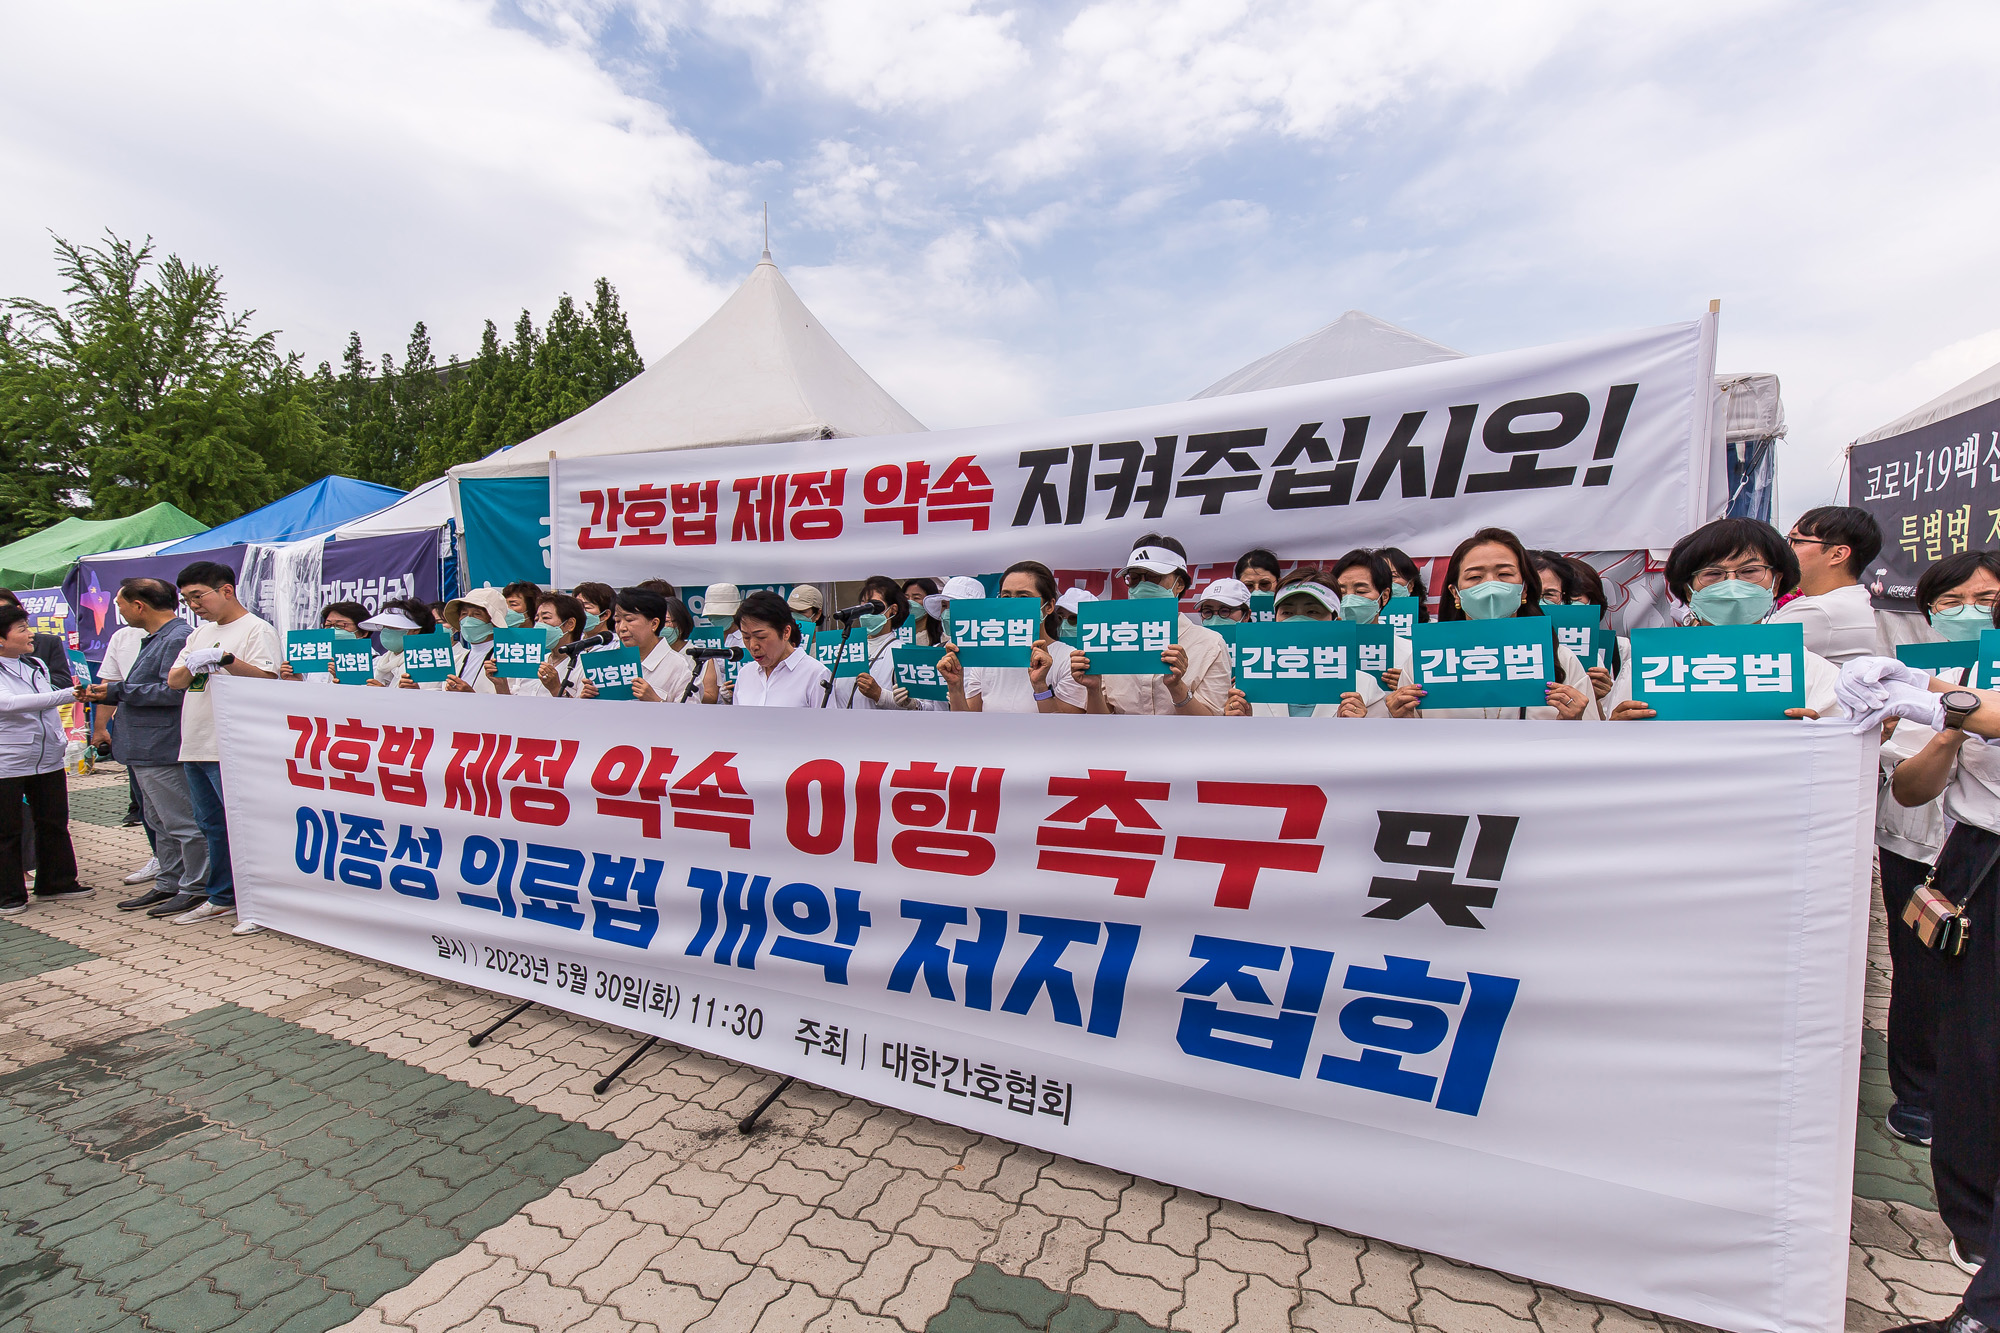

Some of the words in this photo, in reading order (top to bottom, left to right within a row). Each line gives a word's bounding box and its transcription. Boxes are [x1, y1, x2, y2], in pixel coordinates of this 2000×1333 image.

[577, 479, 721, 550] 간호법
[731, 468, 848, 543] 제정
[863, 455, 995, 536] 약속
[1011, 383, 1640, 527] 지켜주십시오!
[1899, 504, 1971, 563] 특별법
[955, 618, 1034, 647] 간호법
[1082, 621, 1171, 653] 간호법
[288, 642, 332, 661] 간호법
[335, 653, 370, 672] 간호법
[405, 647, 452, 669] 간호법
[495, 643, 542, 664] 간호법
[818, 642, 865, 665] 간호법
[1242, 645, 1347, 680] 간호법
[1420, 643, 1544, 684] 간호법
[586, 662, 639, 689] 간호법
[1641, 653, 1793, 693] 간호법
[285, 715, 435, 809] 간호법
[443, 731, 580, 828] 제정
[590, 744, 756, 851] 약속
[785, 758, 1006, 877] 이행
[1035, 769, 1329, 910] 촉구
[1361, 809, 1521, 930] 및
[294, 805, 443, 901] 이종성
[456, 834, 666, 950] 의료법
[684, 866, 872, 986] 개악
[886, 898, 1143, 1039] 저지
[1174, 934, 1521, 1118] 집회
[431, 934, 466, 963] 일시
[484, 946, 549, 984] 2023년
[556, 962, 588, 995] 5월
[594, 970, 683, 1020] 30일(화)
[691, 993, 764, 1040] 11:30
[795, 1018, 849, 1065] 주최
[881, 1041, 1073, 1126] 대한간호협회
